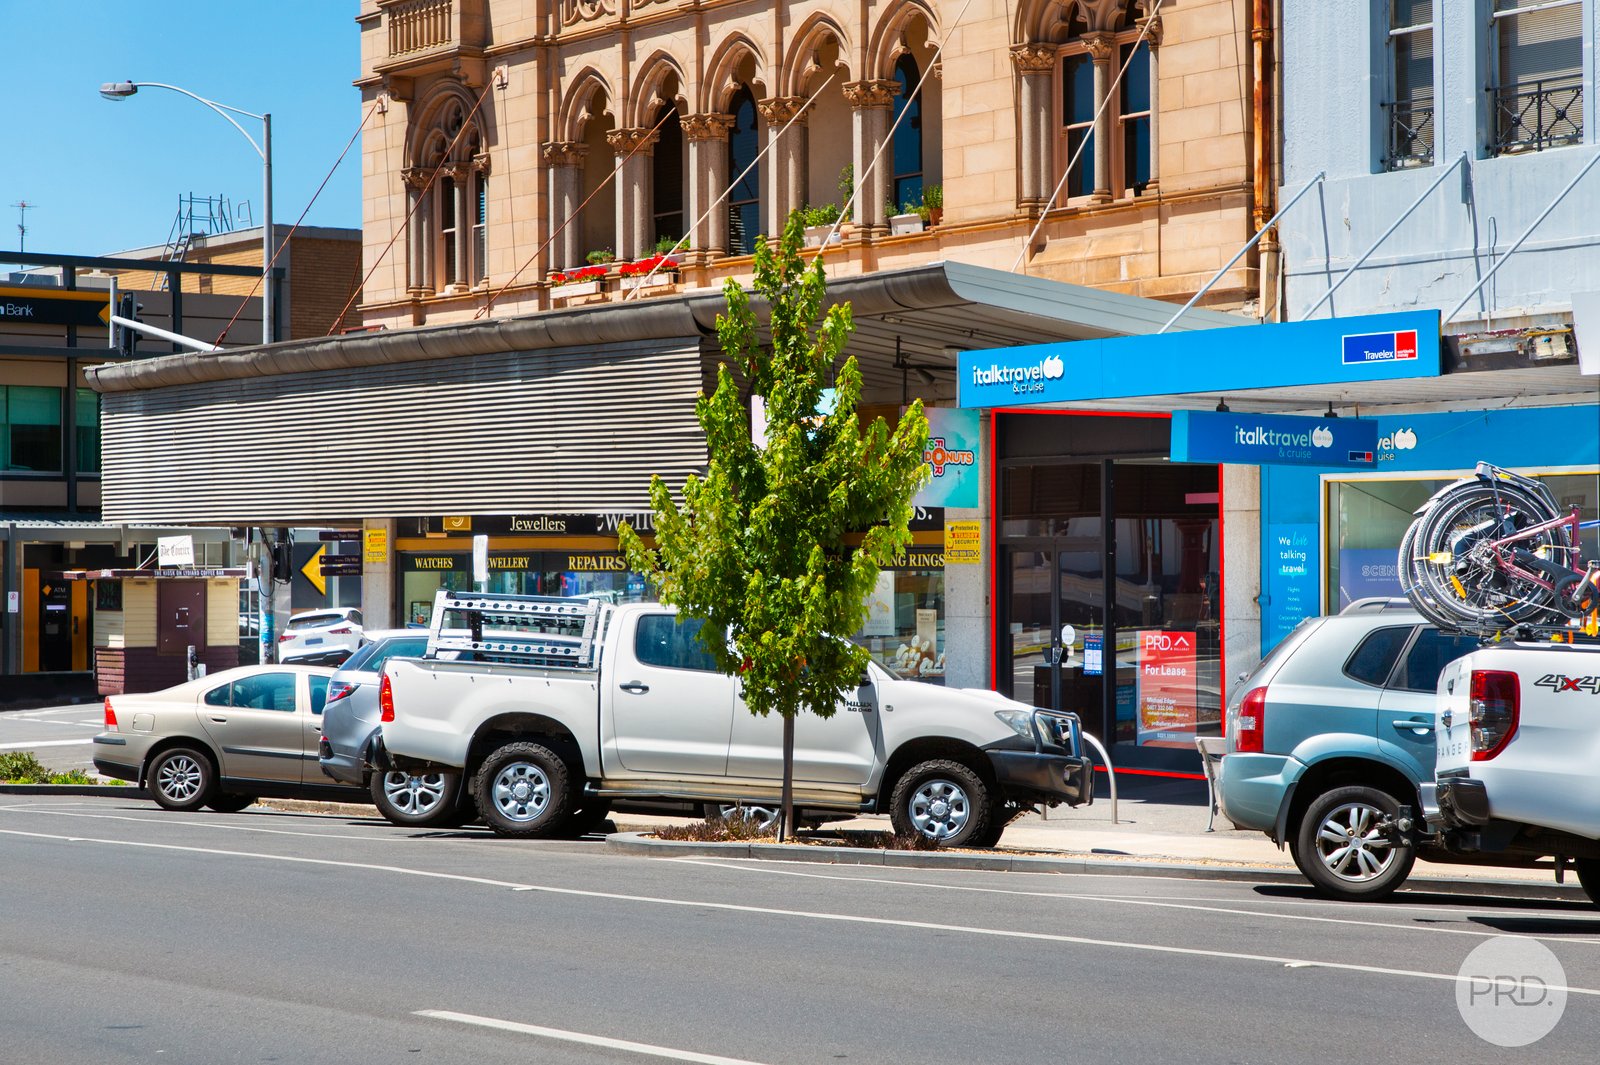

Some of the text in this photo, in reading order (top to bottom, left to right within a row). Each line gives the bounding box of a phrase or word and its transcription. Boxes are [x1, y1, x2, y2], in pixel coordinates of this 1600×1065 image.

[1364, 350, 1394, 360] Travelex
[973, 361, 1044, 385] italktravel
[1013, 380, 1044, 392] & cruise
[1235, 425, 1312, 448] italktravel
[925, 447, 973, 466] DONUTS
[1278, 447, 1312, 459] & cruise
[510, 516, 566, 531] Jewellers
[1278, 531, 1308, 546] We love
[160, 544, 171, 557] The
[1280, 550, 1306, 562] talking
[415, 557, 453, 568] WATCHES
[568, 556, 627, 571] REPAIRS
[908, 554, 945, 567] RINGS
[1282, 563, 1304, 573] travel
[1145, 635, 1173, 651] PRD.
[1145, 664, 1186, 676] For Lease
